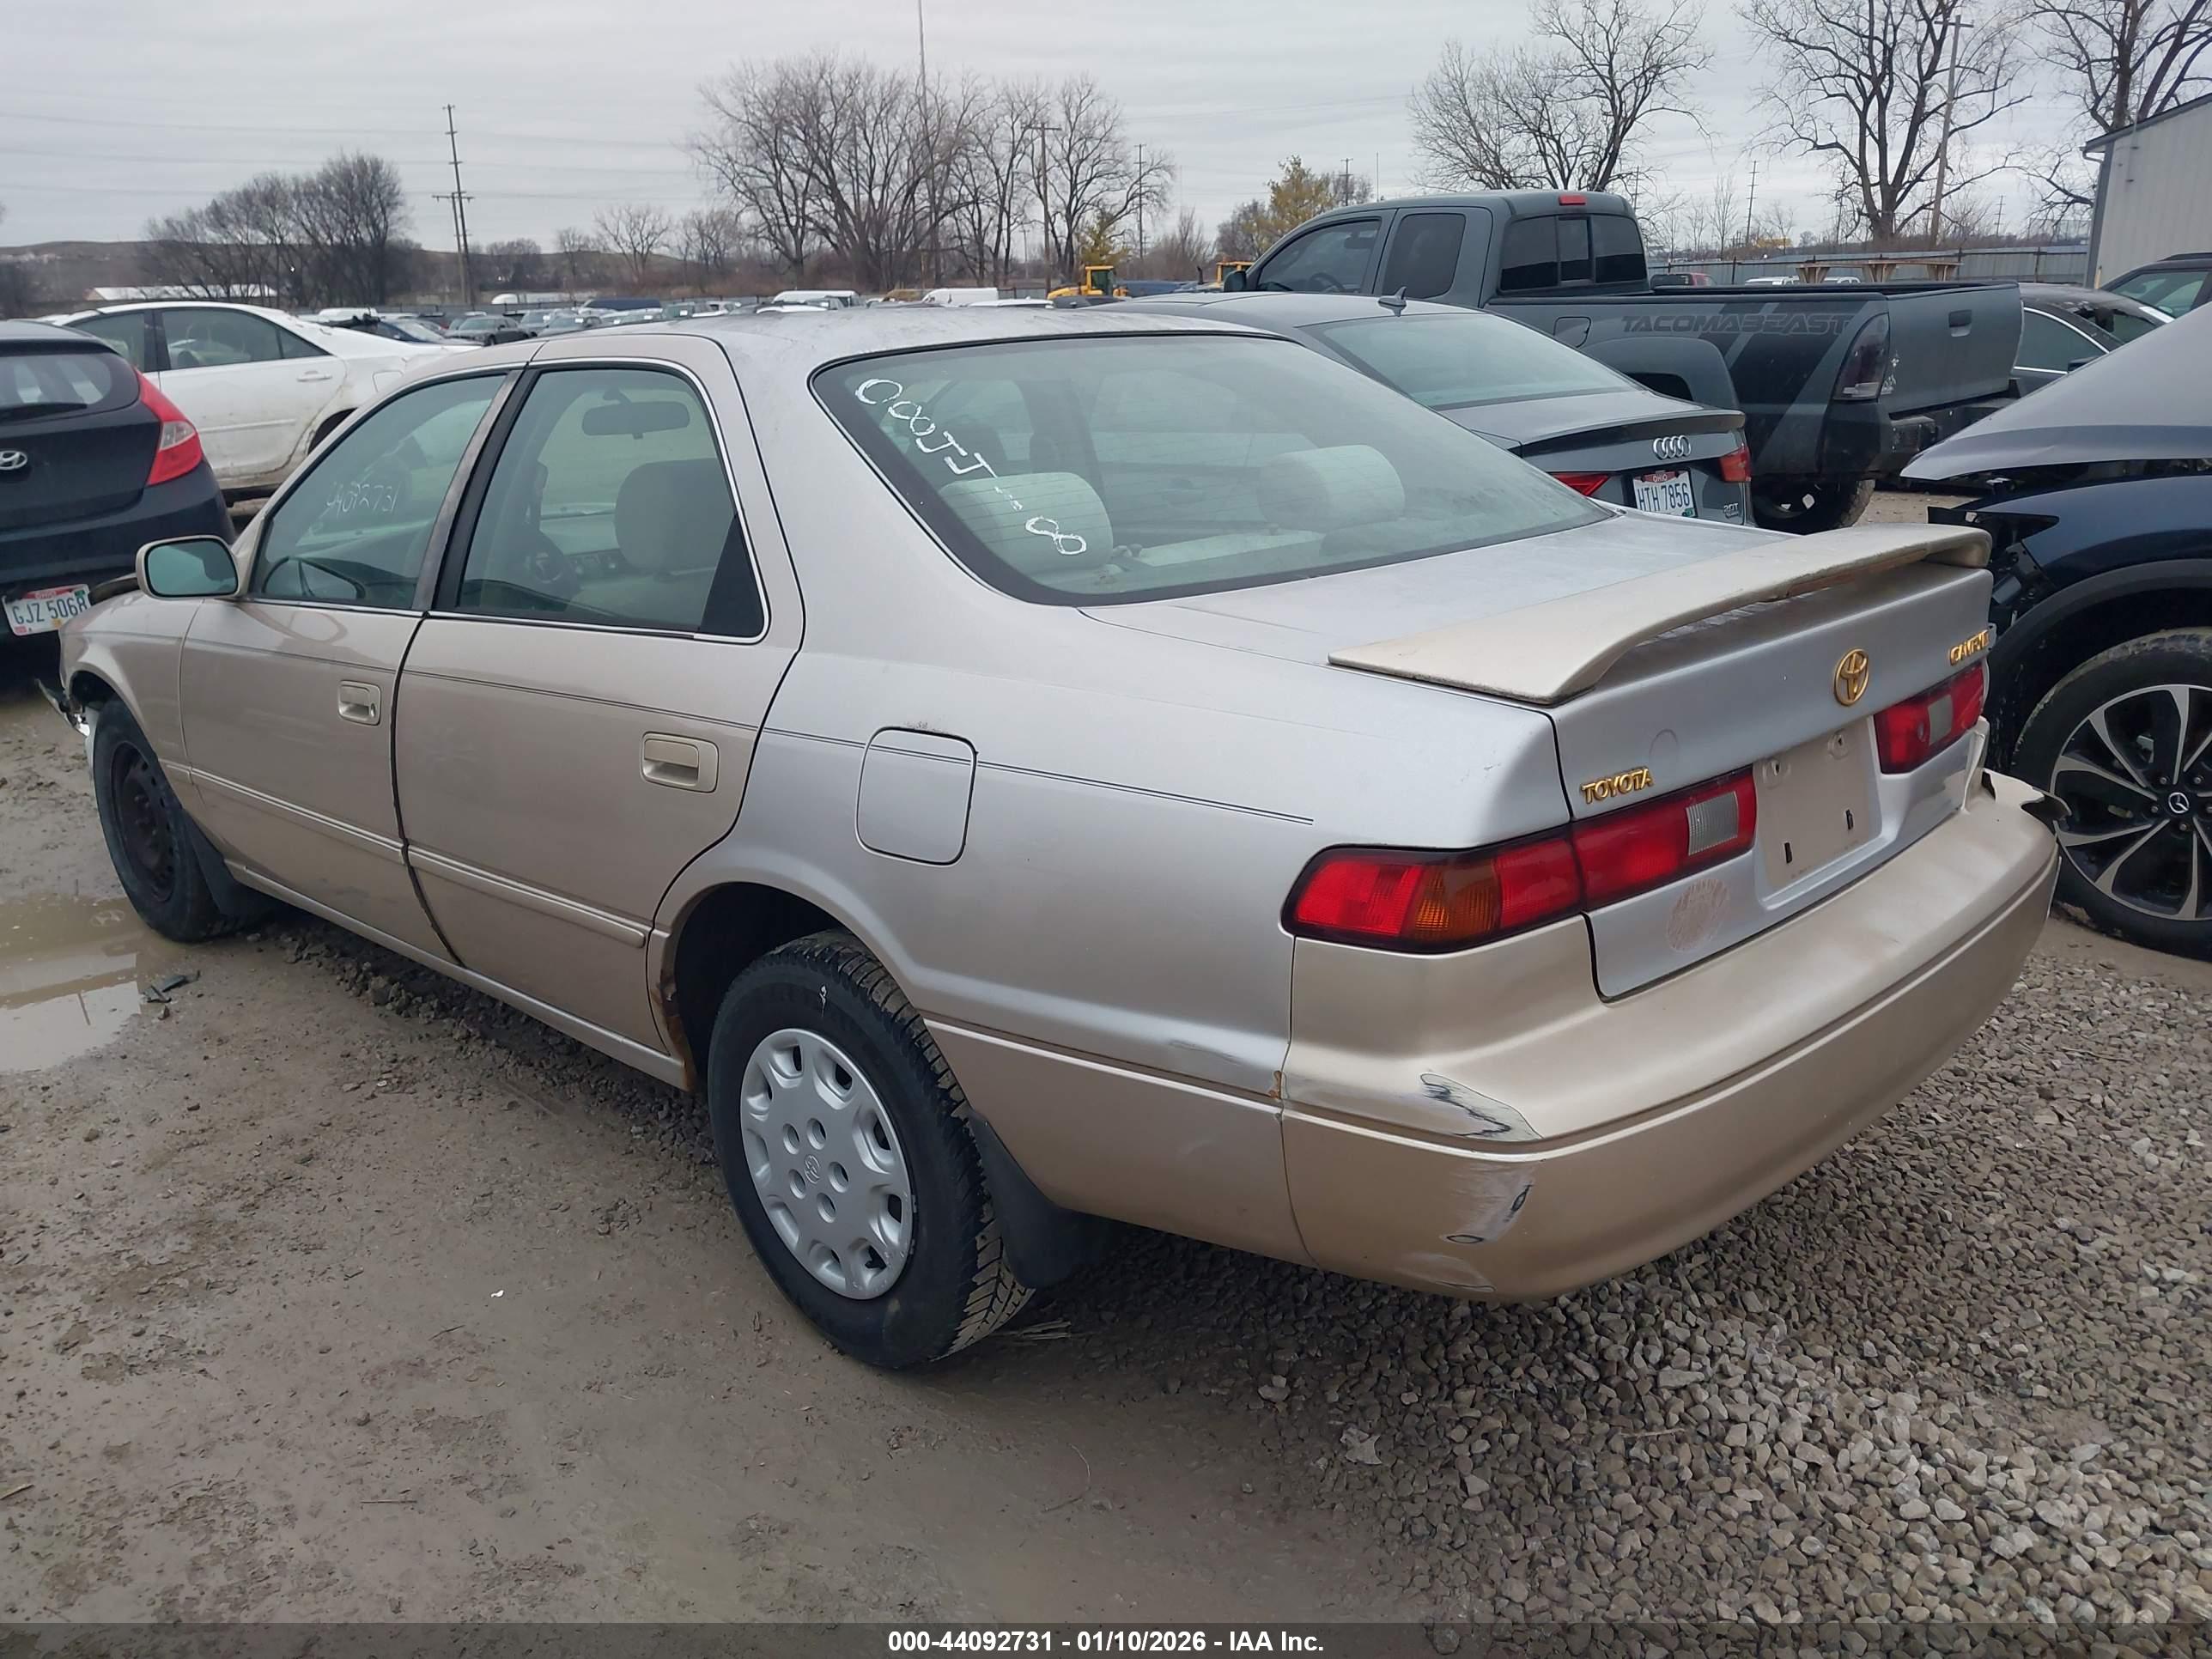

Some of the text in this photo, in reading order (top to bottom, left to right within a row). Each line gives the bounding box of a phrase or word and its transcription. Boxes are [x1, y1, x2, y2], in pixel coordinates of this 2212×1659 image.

[1652, 473, 1668, 483] OHIO
[1637, 483, 1691, 513] HTH 7856
[12, 602, 46, 625] GJZ
[1580, 767, 1654, 805] TOYOTA
